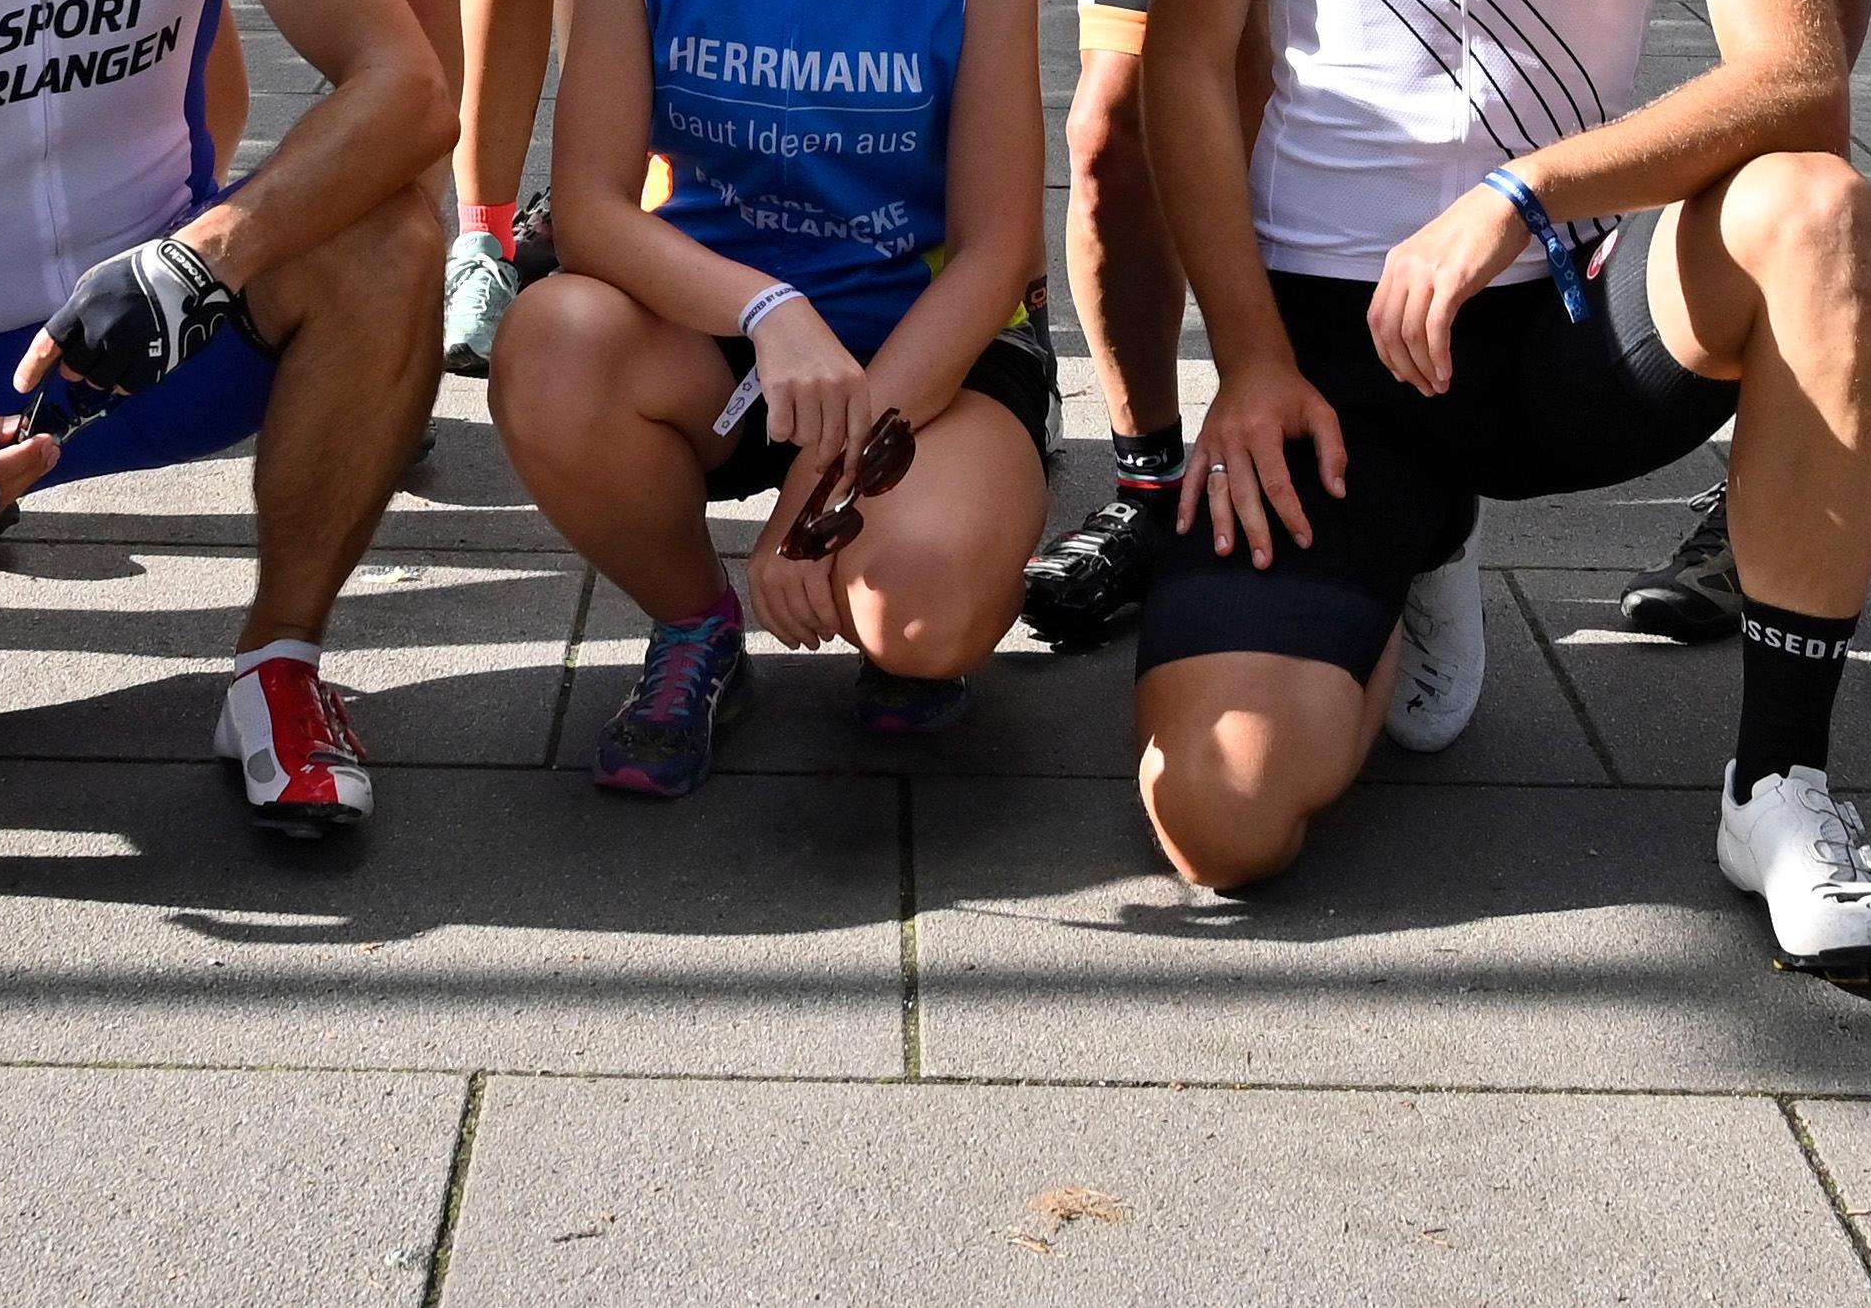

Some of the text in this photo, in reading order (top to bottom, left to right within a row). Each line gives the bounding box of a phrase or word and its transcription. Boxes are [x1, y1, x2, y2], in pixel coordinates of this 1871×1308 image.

[669, 36, 922, 93] HERRMANN
[669, 103, 917, 158] baut Ideen aus
